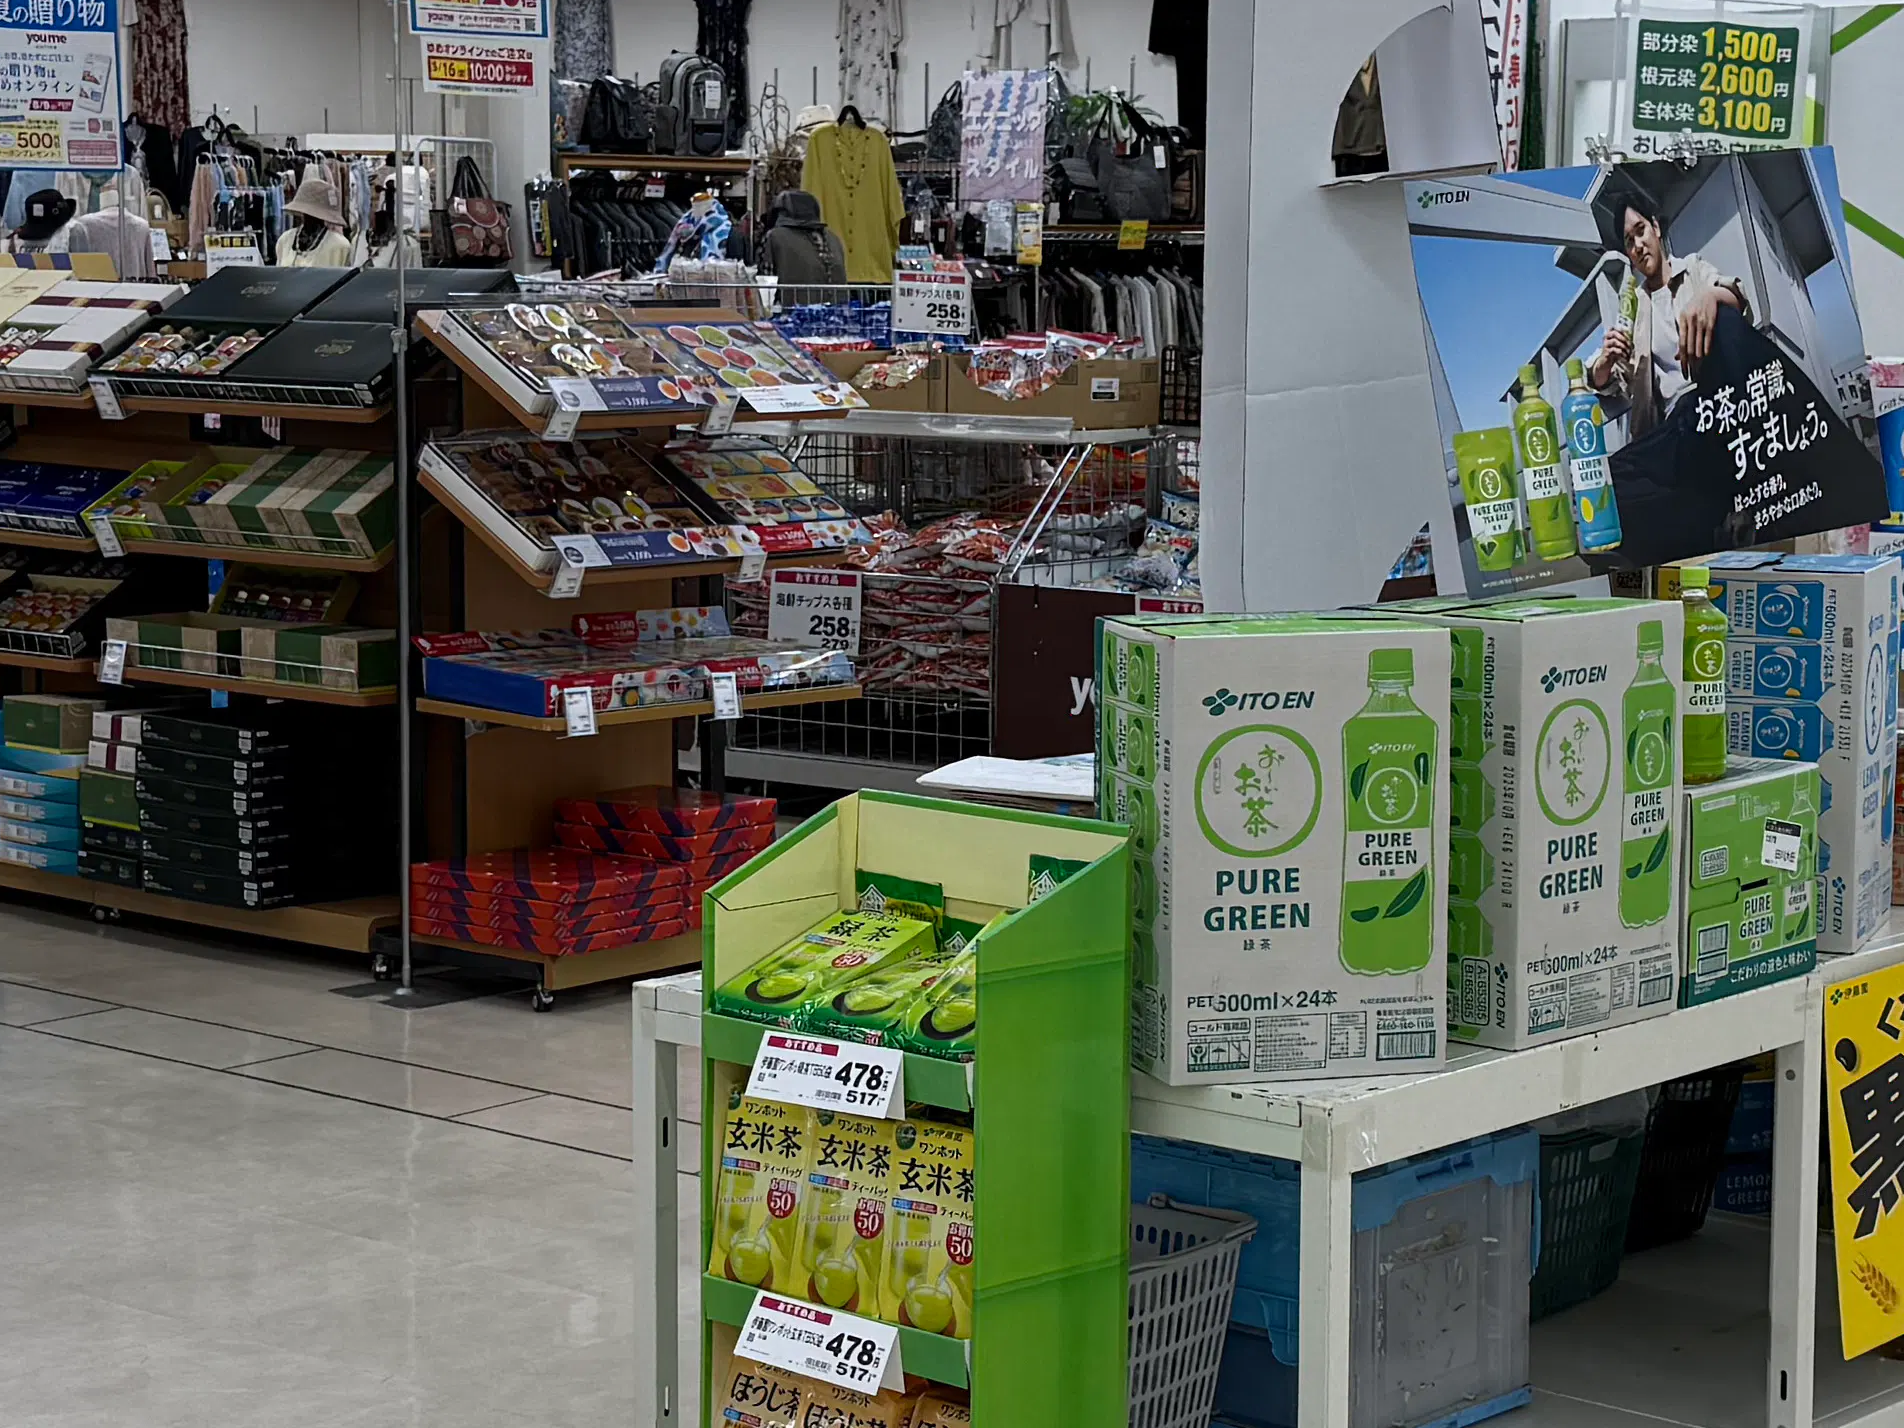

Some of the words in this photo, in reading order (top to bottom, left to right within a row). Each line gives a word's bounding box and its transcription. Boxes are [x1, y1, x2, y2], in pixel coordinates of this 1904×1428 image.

[26, 33, 67, 46] youme
[1642, 32, 1698, 54] 部分染
[1702, 27, 1791, 64] 1,500円
[470, 63, 504, 81] 10:00
[1640, 66, 1697, 88] 根元染
[1699, 62, 1789, 99] 2,600円
[1637, 100, 1695, 122] 全体染
[1698, 96, 1786, 133] 3,100円
[17, 132, 53, 149] 500
[966, 156, 1039, 180] スタイル
[926, 302, 961, 319] 258
[1696, 358, 1796, 434] お茶の常識、
[1727, 401, 1829, 481] すてましょう。
[1734, 589, 1744, 629] GREEN
[1746, 589, 1755, 630] LEMON
[808, 615, 851, 638] 258
[1634, 791, 1662, 809] PURE
[1631, 807, 1665, 826] GREEN
[1365, 833, 1412, 847] PURE
[1547, 832, 1598, 864] PURE
[1358, 850, 1418, 867] GREEN
[1215, 866, 1300, 896] PURE
[1539, 864, 1604, 900] GREEN
[1743, 892, 1773, 918] PURE
[1204, 903, 1311, 932] GREEN
[1739, 914, 1775, 941] GREEN
[1243, 938, 1272, 952] 緑茶
[835, 1061, 884, 1091] 478
[745, 1102, 786, 1119] ワンポット
[846, 1090, 878, 1107] 517
[726, 1117, 803, 1159] 玄米茶
[838, 1119, 878, 1137] ワンポット
[817, 1134, 891, 1179] 玄米茶
[919, 1142, 963, 1160] ワンポット
[770, 1192, 792, 1211] 50
[857, 1213, 879, 1231] 50
[826, 1332, 877, 1366] 478
[836, 1362, 869, 1382] 517
